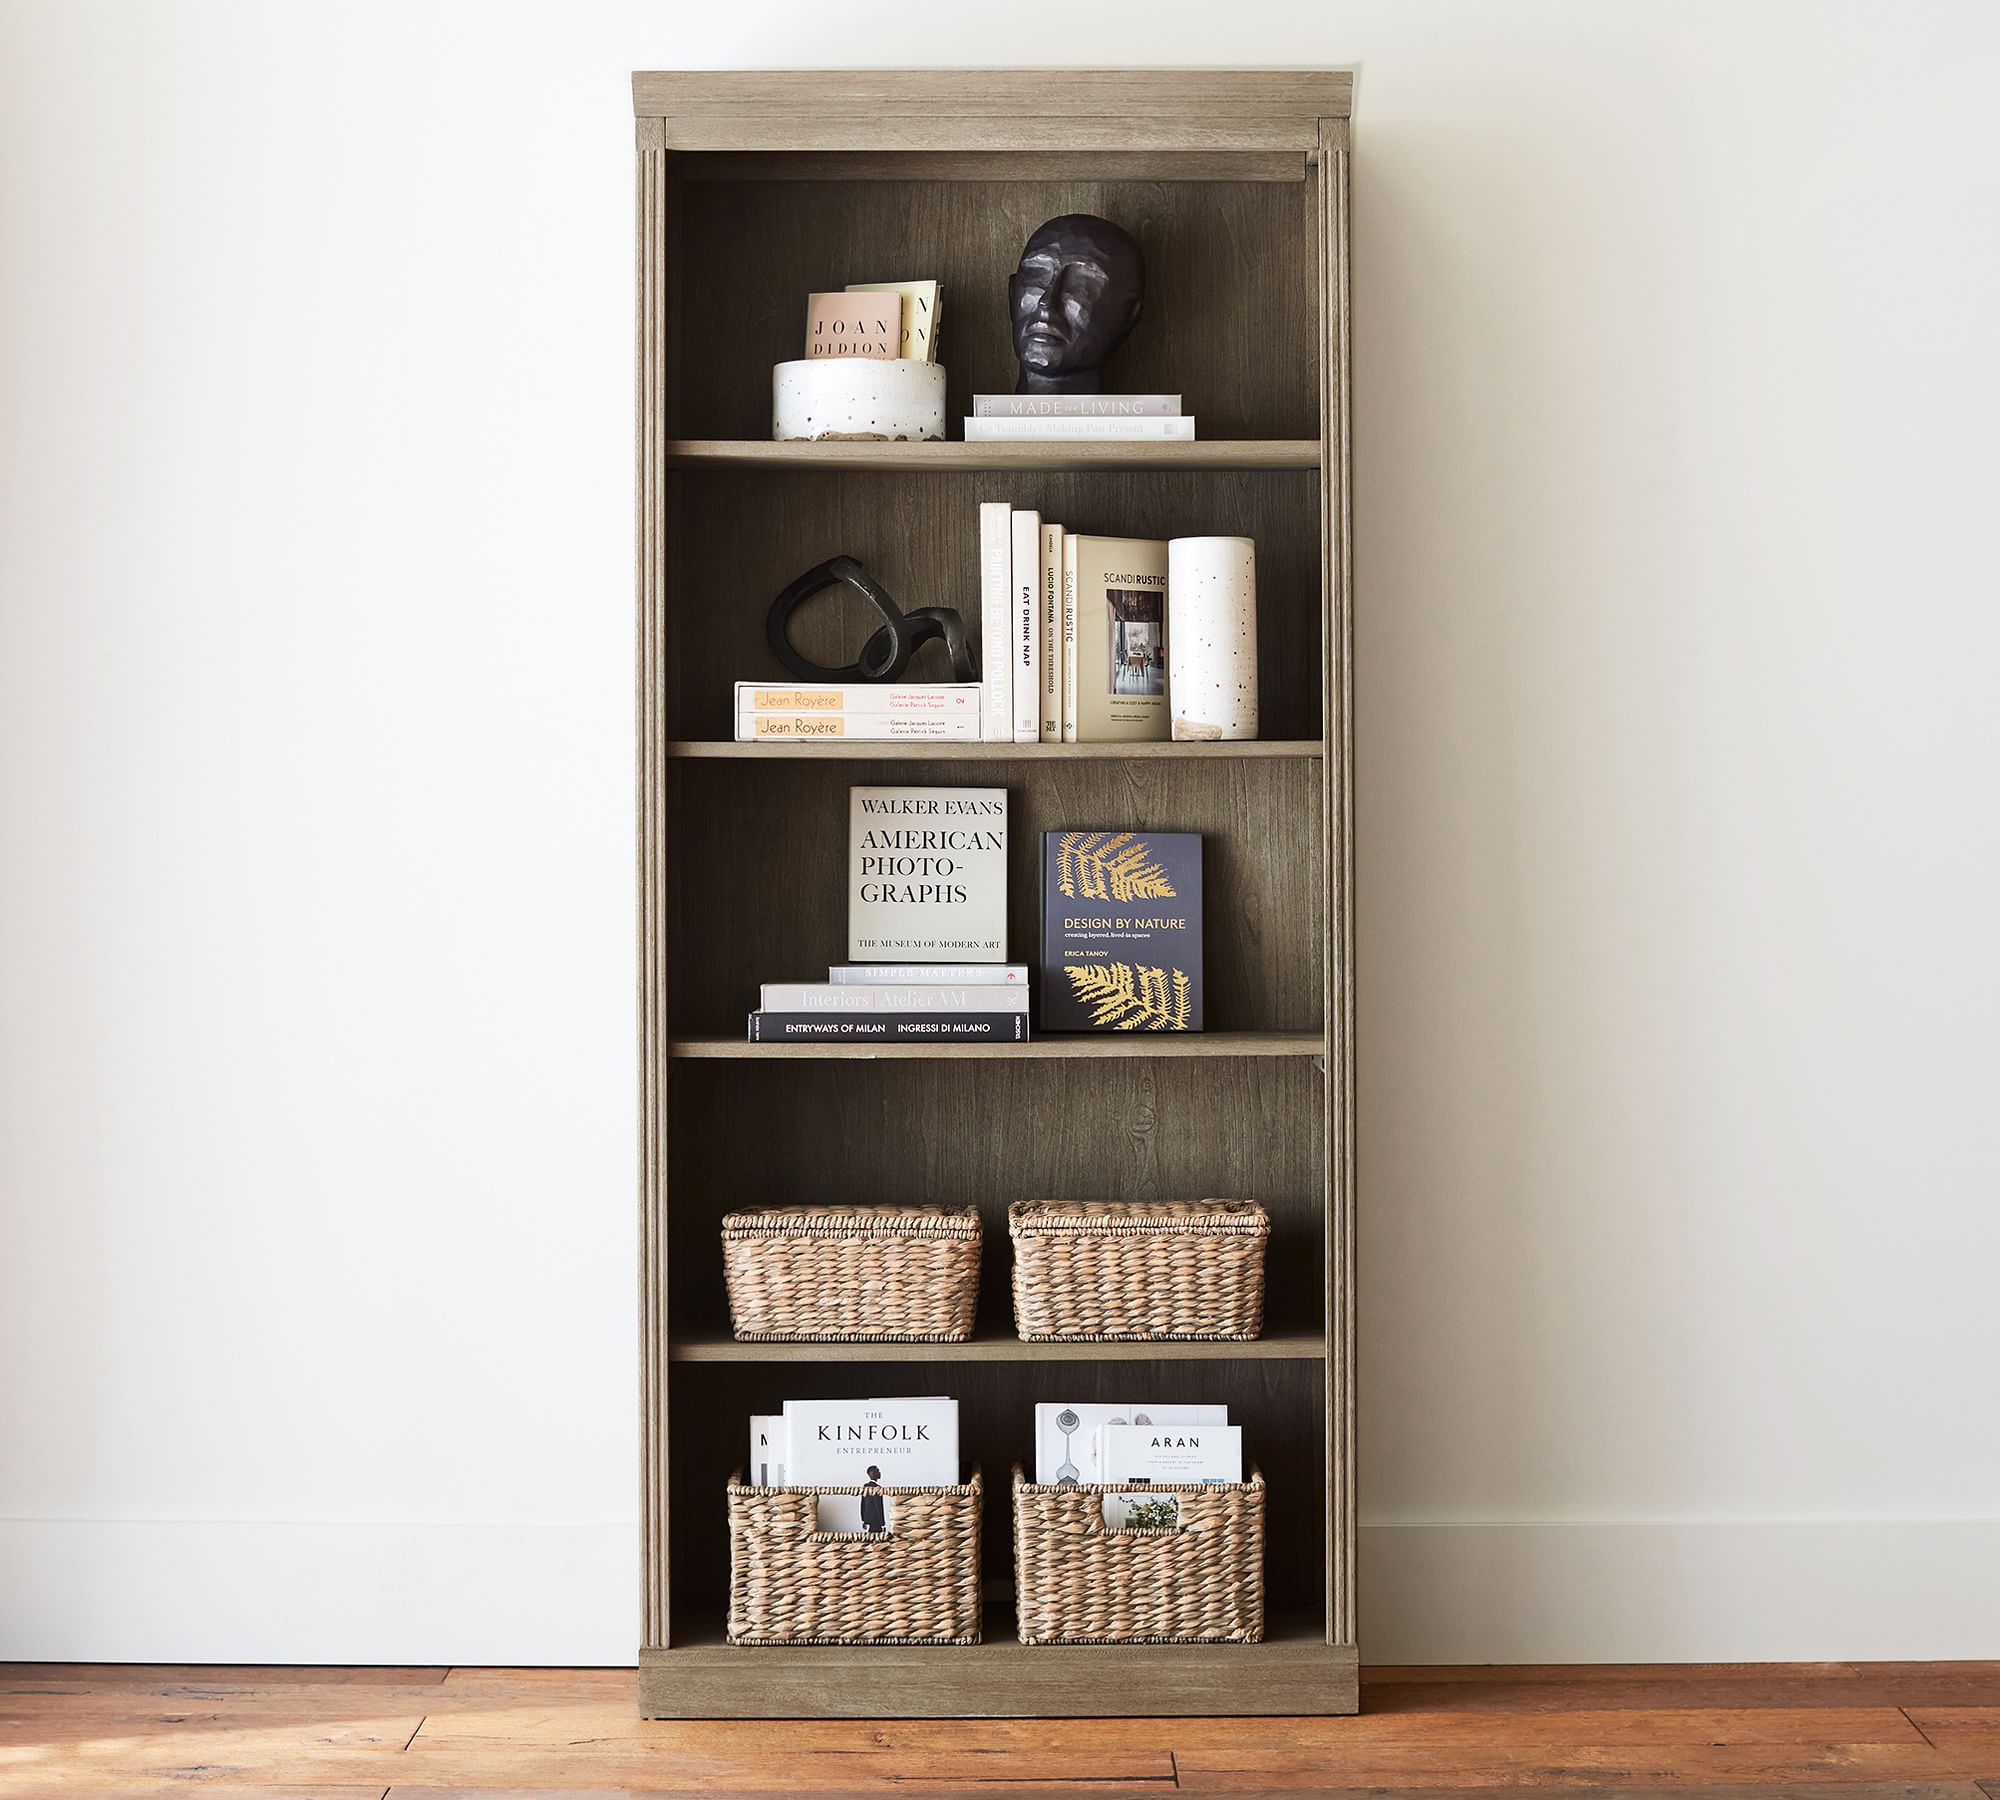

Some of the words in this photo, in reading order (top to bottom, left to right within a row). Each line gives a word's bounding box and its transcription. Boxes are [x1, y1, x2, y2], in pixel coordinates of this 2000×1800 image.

[815, 320, 888, 335] JOAN
[814, 343, 888, 355] DIDION
[1010, 401, 1062, 415] MADE
[1081, 401, 1144, 415] LIVING
[1047, 423, 1083, 435] Making
[1109, 423, 1143, 433] Present
[1104, 572, 1166, 586] SCANDIRUSTIC
[1022, 587, 1030, 606] EAT
[1065, 571, 1073, 643] SCANDIRUSTIC
[1048, 628, 1055, 638] ON
[1023, 645, 1031, 667] NAP
[761, 692, 790, 707] Jean
[795, 691, 837, 708] Royère
[761, 719, 790, 735] Jean
[796, 718, 837, 736] Royère
[861, 799, 940, 814] WALKER
[945, 801, 1004, 816] EVANS
[860, 830, 1004, 850] AMERICAN
[861, 857, 964, 876] PHOTO-
[860, 884, 967, 904] GRAPHS
[1065, 918, 1112, 930] DESIGN
[1116, 918, 1132, 930] BY
[1135, 919, 1186, 930] NATURE
[1065, 931, 1088, 939] creating
[880, 940, 921, 948] MUSEUM
[924, 940, 937, 948] OF
[939, 940, 980, 949] MODERN
[982, 941, 1001, 949] ART
[864, 968, 914, 978] SIMPLE
[802, 990, 869, 1007] Interiors
[880, 990, 933, 1007] Atelier
[937, 991, 967, 1007] AM
[785, 1024, 838, 1033] ENTRYWAYS
[841, 1024, 853, 1033] OF
[856, 1024, 886, 1033] MILAN
[897, 1024, 938, 1033] INGRESSI
[941, 1024, 951, 1033] DI
[953, 1023, 991, 1033] MILANO
[818, 1424, 930, 1441] KINFOLK
[1151, 1437, 1200, 1448] ARAN
[836, 1447, 912, 1455] ENTREPRENEUR
